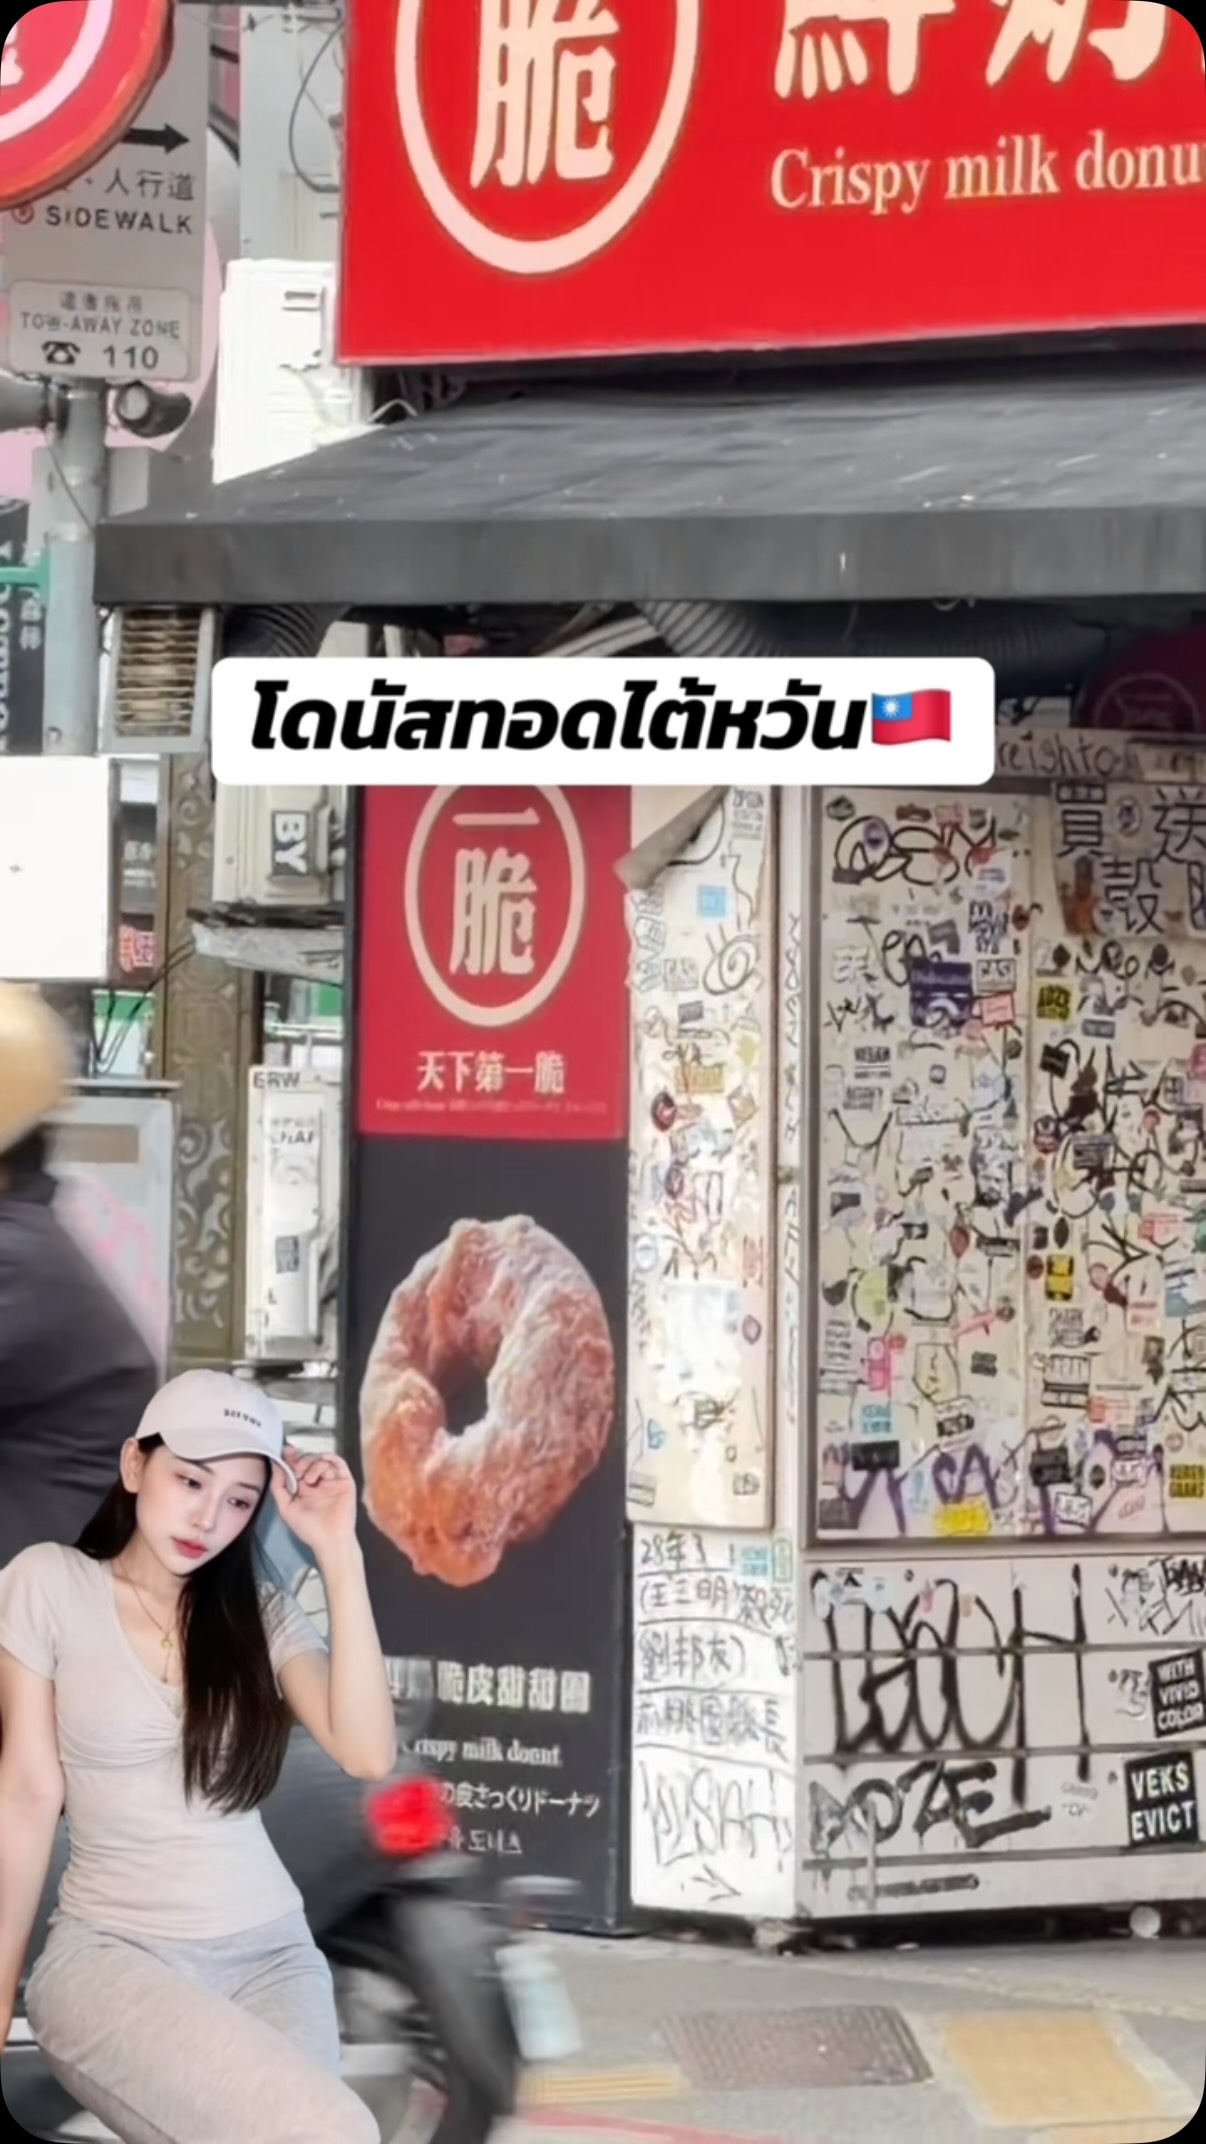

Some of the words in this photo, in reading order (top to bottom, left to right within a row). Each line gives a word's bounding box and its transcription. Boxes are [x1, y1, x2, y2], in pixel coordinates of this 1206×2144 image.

[470, 0, 619, 189] 脆
[771, 147, 931, 216] Crispy
[945, 134, 1061, 199] milk
[46, 205, 192, 234] SIDEWALK
[130, 319, 180, 339] ZONE
[103, 345, 159, 370] 110
[417, 1050, 565, 1094] 天下第一脆
[1131, 1761, 1190, 1800] VEKS
[1131, 1801, 1194, 1841] EVICT
